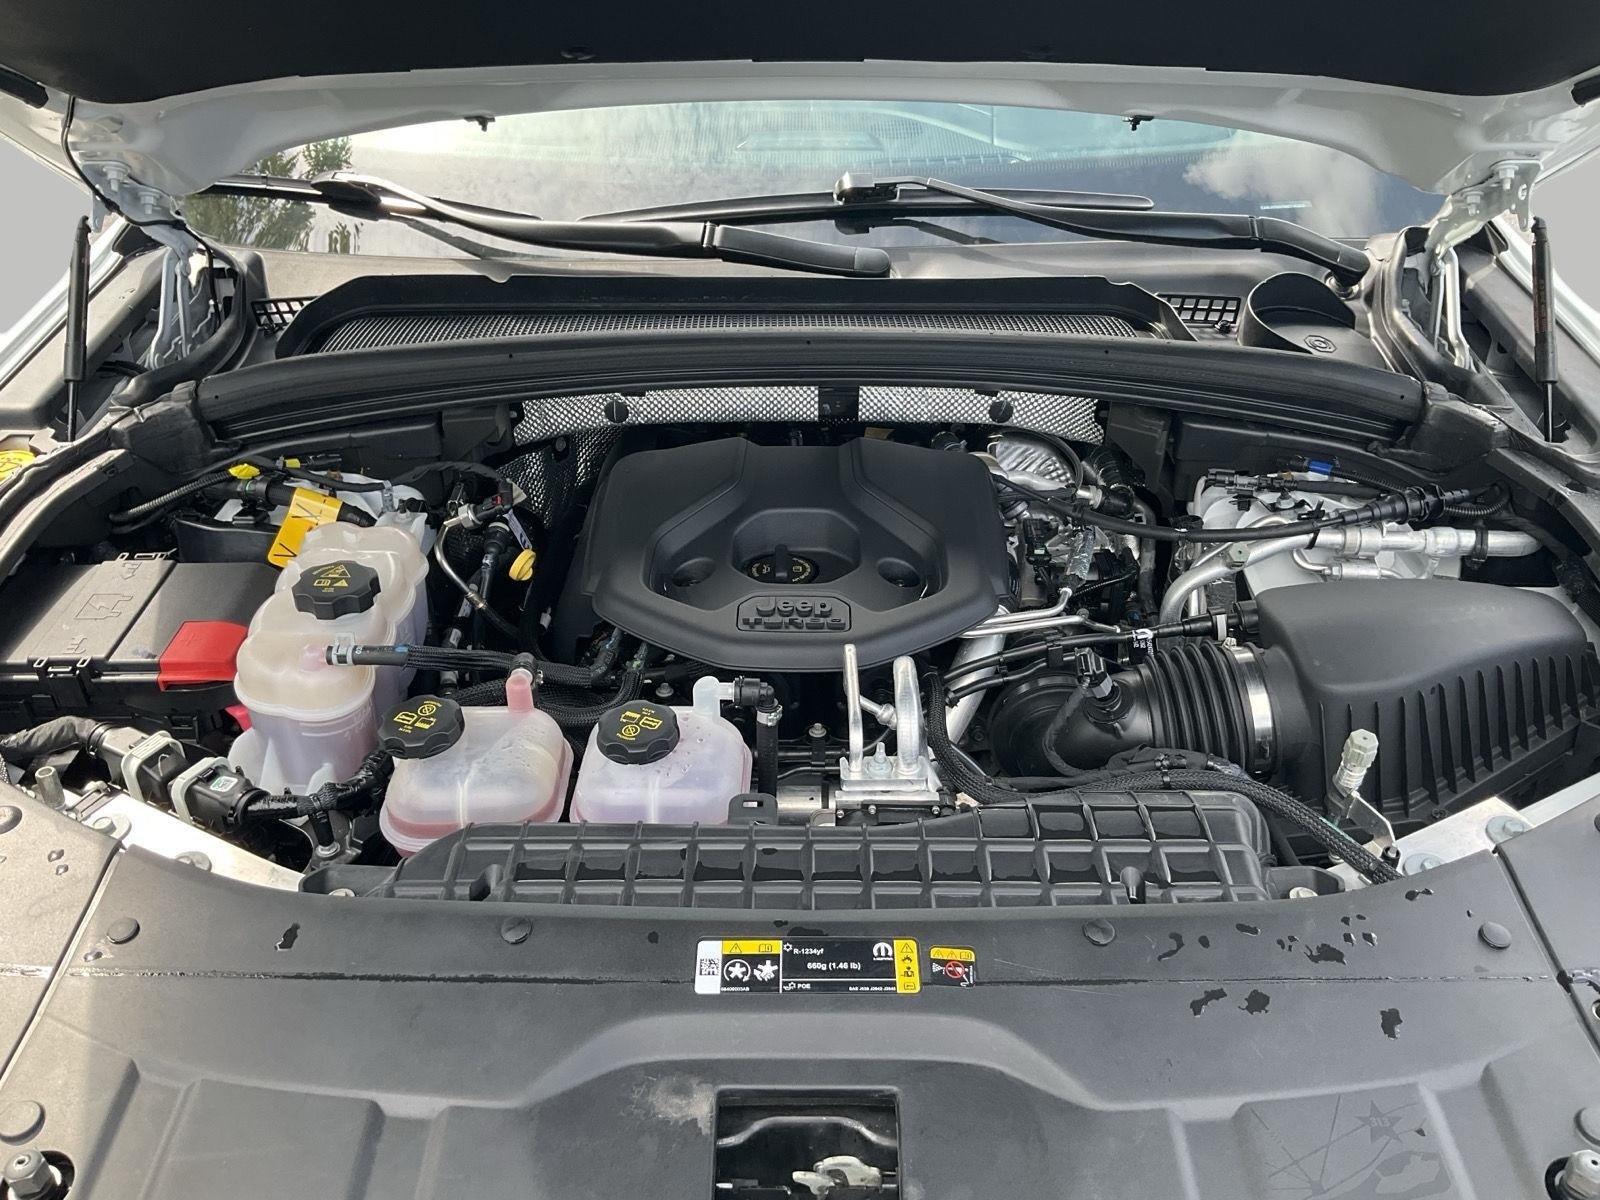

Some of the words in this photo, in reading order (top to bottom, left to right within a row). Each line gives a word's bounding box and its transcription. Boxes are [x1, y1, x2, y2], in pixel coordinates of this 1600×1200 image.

[756, 597, 832, 617] Jeep
[794, 948, 824, 956] R-1234yf
[807, 962, 827, 970] 660g
[850, 962, 861, 970] lb)
